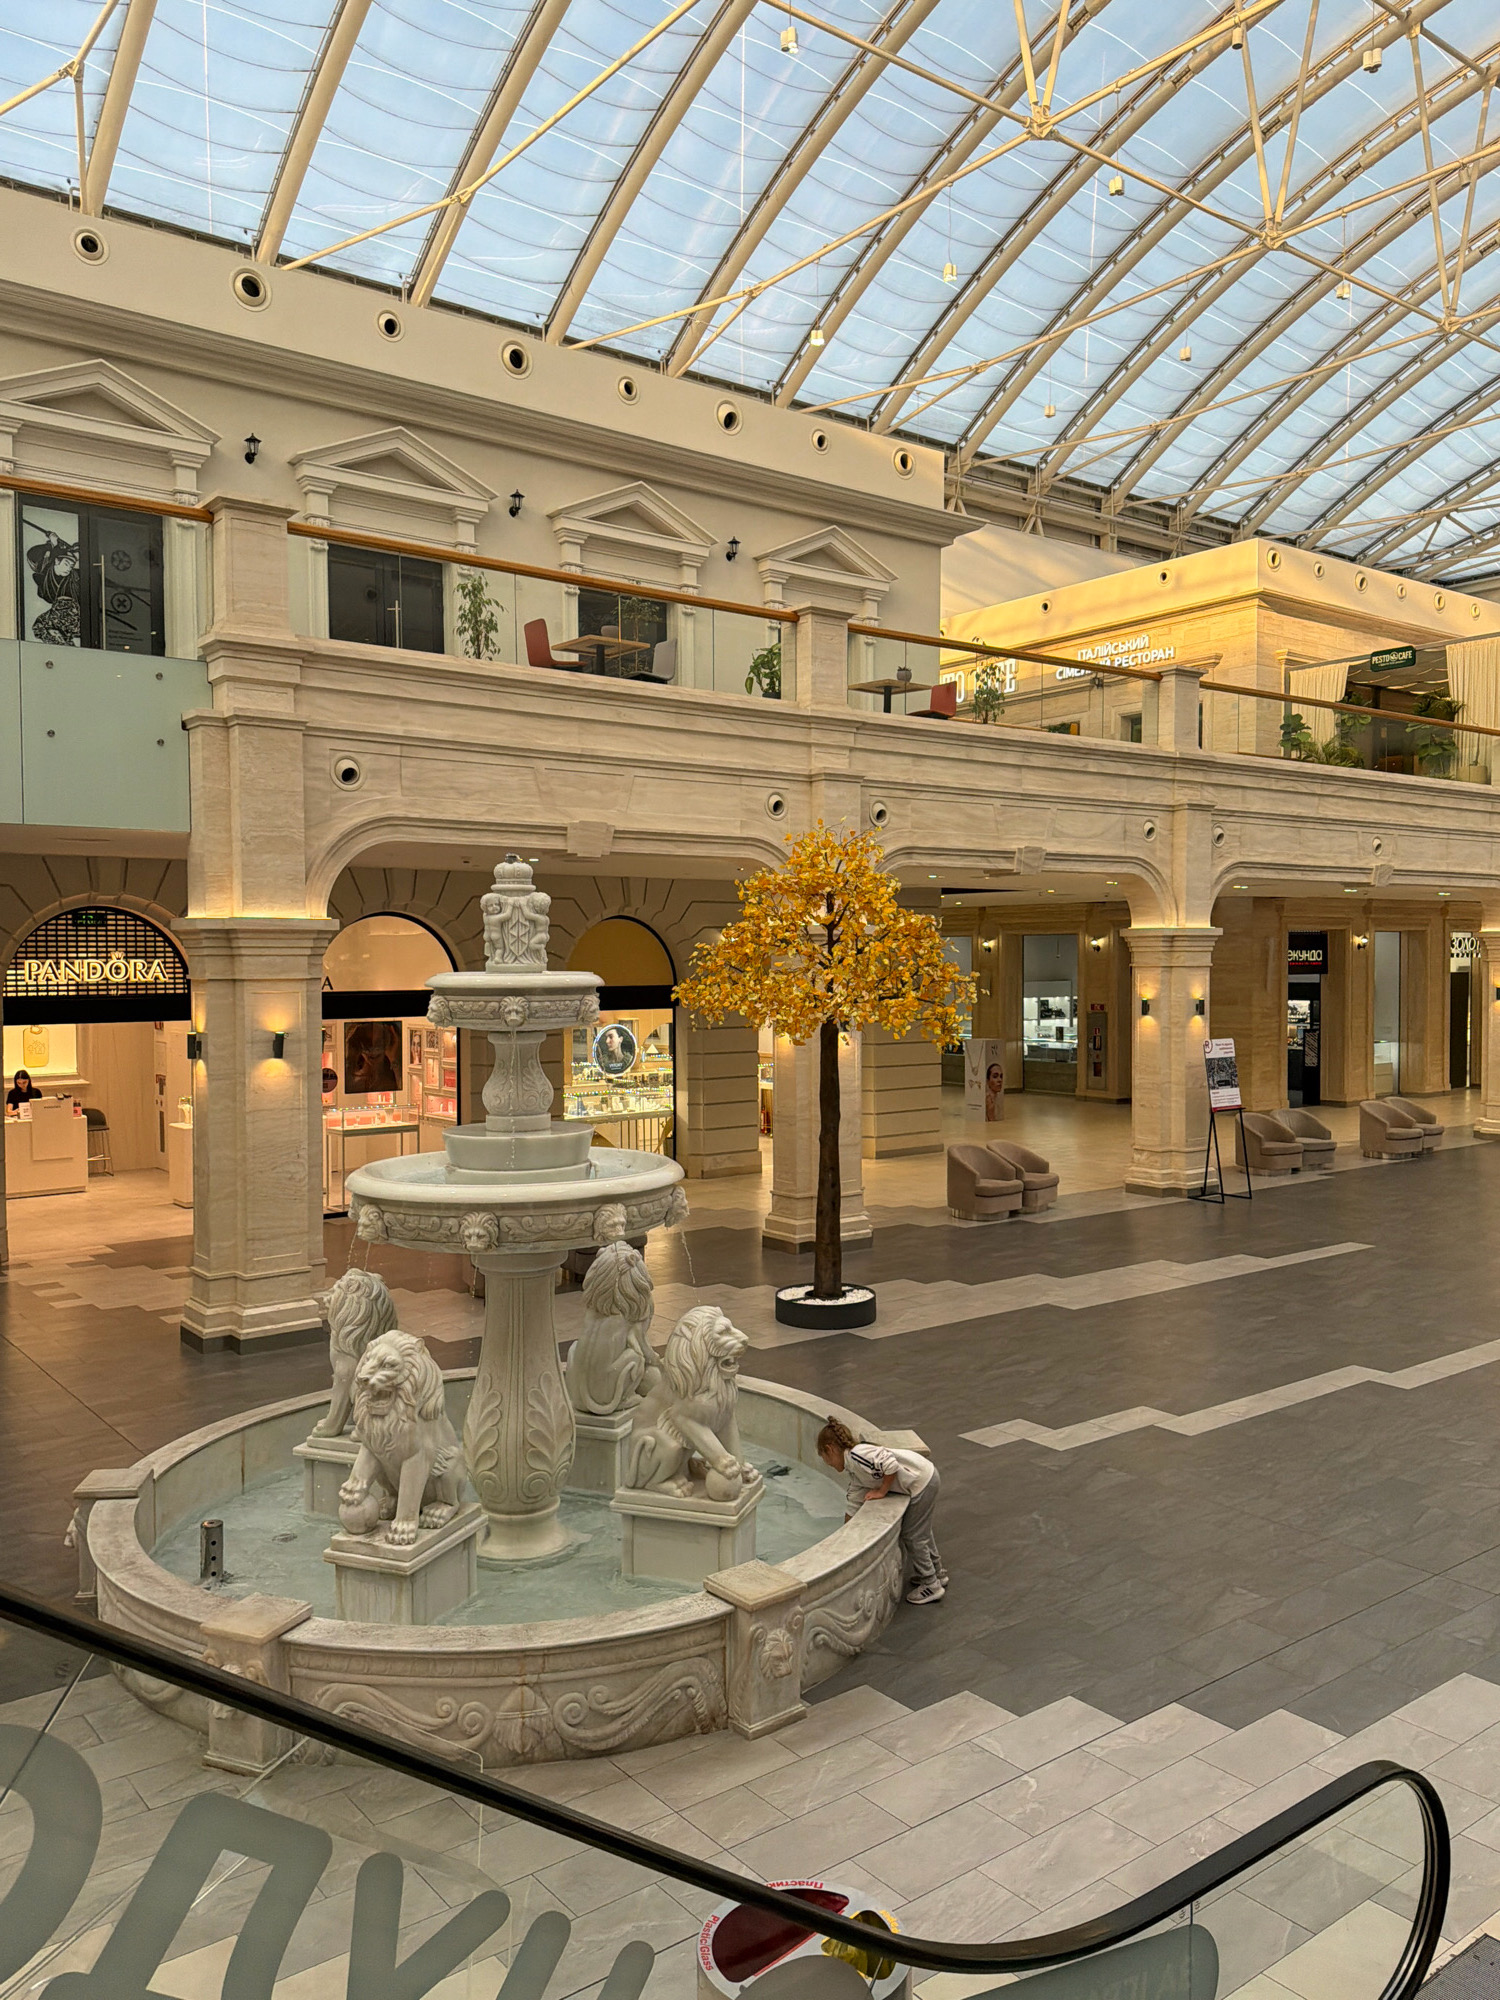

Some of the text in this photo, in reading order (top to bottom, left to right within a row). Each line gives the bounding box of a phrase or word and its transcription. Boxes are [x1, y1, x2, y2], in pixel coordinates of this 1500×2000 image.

[1077, 634, 1149, 662] ІТАЛІЙСЬКИЙ
[1114, 646, 1175, 669] РЕСТОРАН
[1372, 655, 1390, 665] PESTO
[1398, 650, 1413, 660] CAFE
[24, 958, 169, 984] PANDORA
